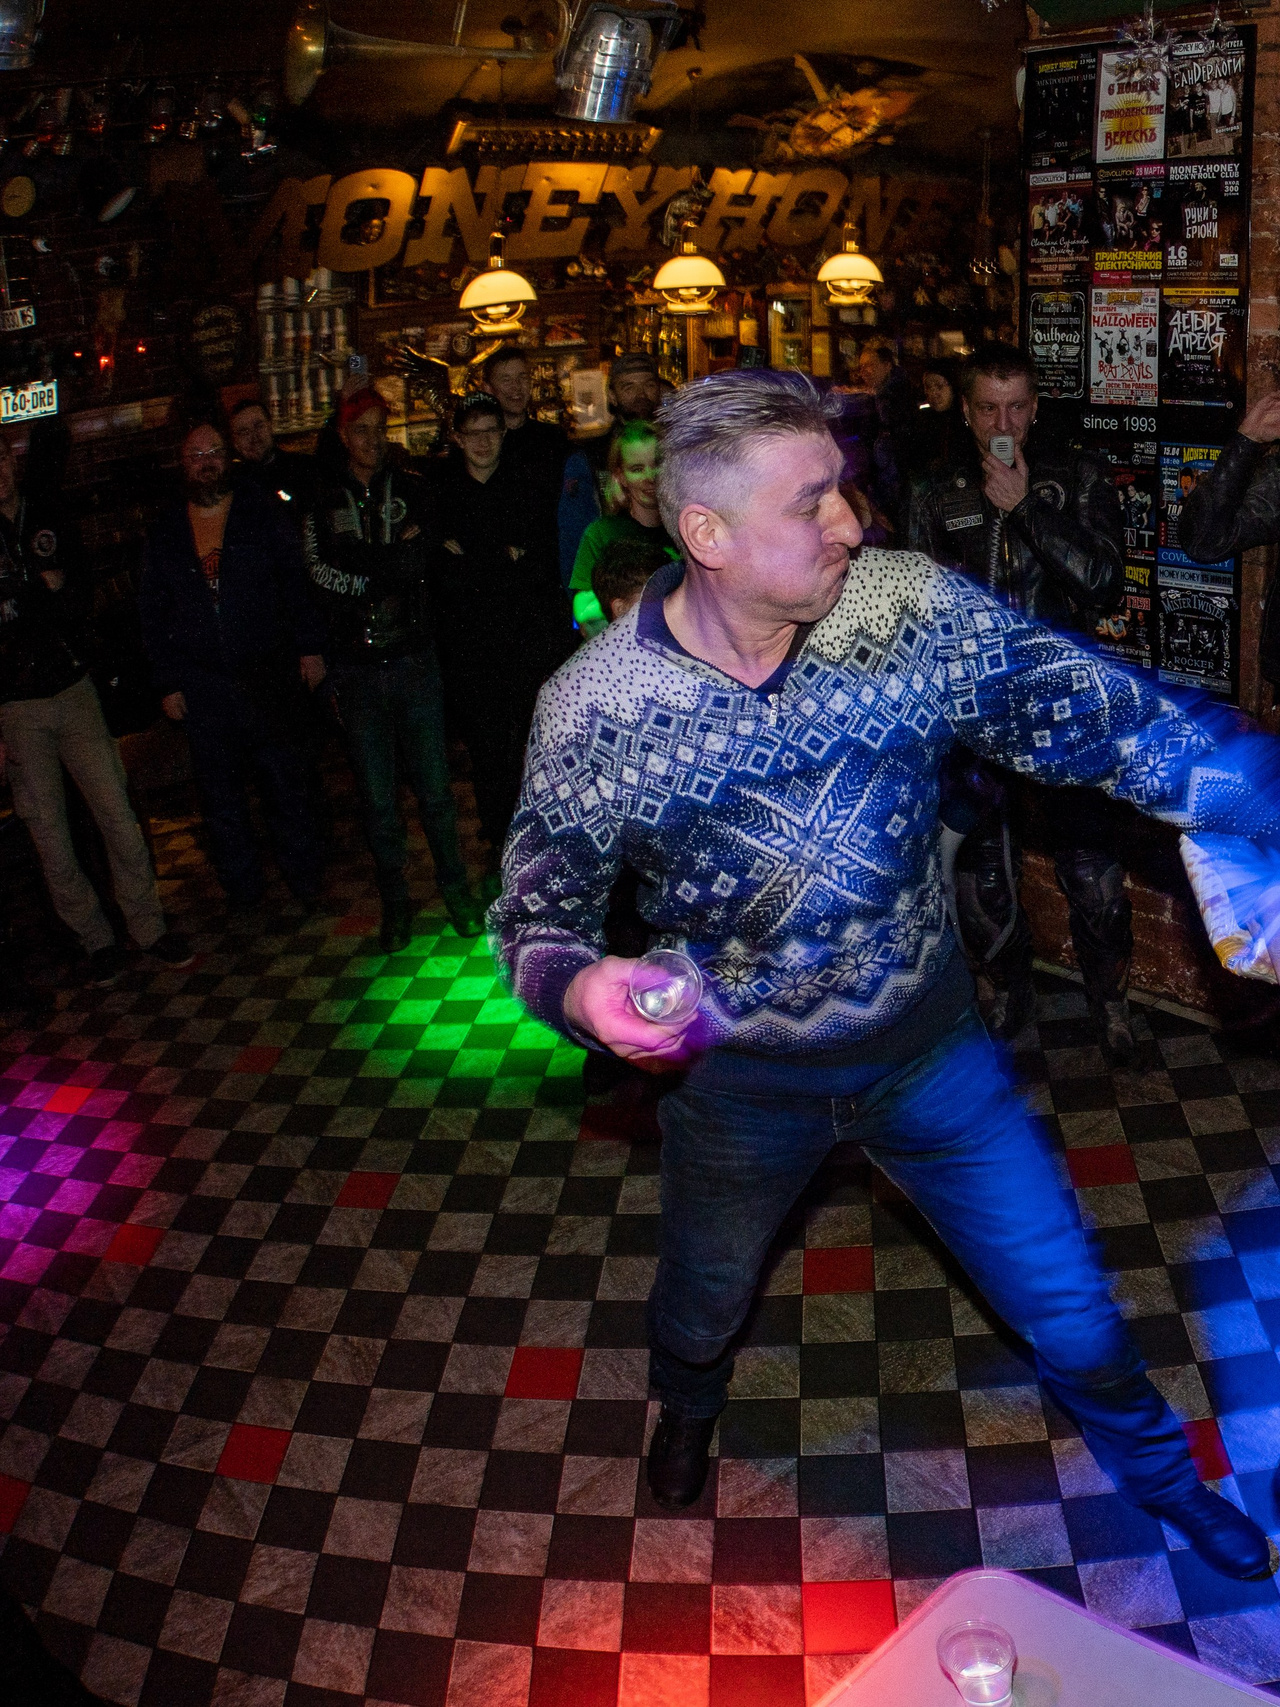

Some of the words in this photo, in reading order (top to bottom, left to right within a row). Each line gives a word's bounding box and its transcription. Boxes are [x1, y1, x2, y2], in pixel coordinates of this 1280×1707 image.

[1143, 165, 1165, 176] МАРТА
[1169, 163, 1240, 174] MONEY-HONEY
[1220, 171, 1240, 179] CLUB
[1224, 185, 1240, 193] 300
[1184, 206, 1208, 226] РУКИ
[1185, 221, 1218, 239] БРЮКИ
[1095, 251, 1162, 261] ПРИКЛЮЧЕНИЯ
[1167, 245, 1188, 260] 16
[1094, 261, 1162, 271] ЭЛЕКТРОНИКОВ
[1167, 259, 1188, 267] мая
[1092, 313, 1157, 328] HALLOWEEN
[1168, 327, 1228, 357] АПРЕЛЯ
[1083, 414, 1119, 430] since
[1123, 415, 1157, 433] 1993
[1182, 446, 1209, 464] MONEY
[1161, 551, 1196, 564] COVE
[1159, 568, 1180, 579] MONEY
[1161, 597, 1191, 615] MISTER
[1191, 593, 1226, 621] TWISTER
[1174, 655, 1215, 670] ROCKER
